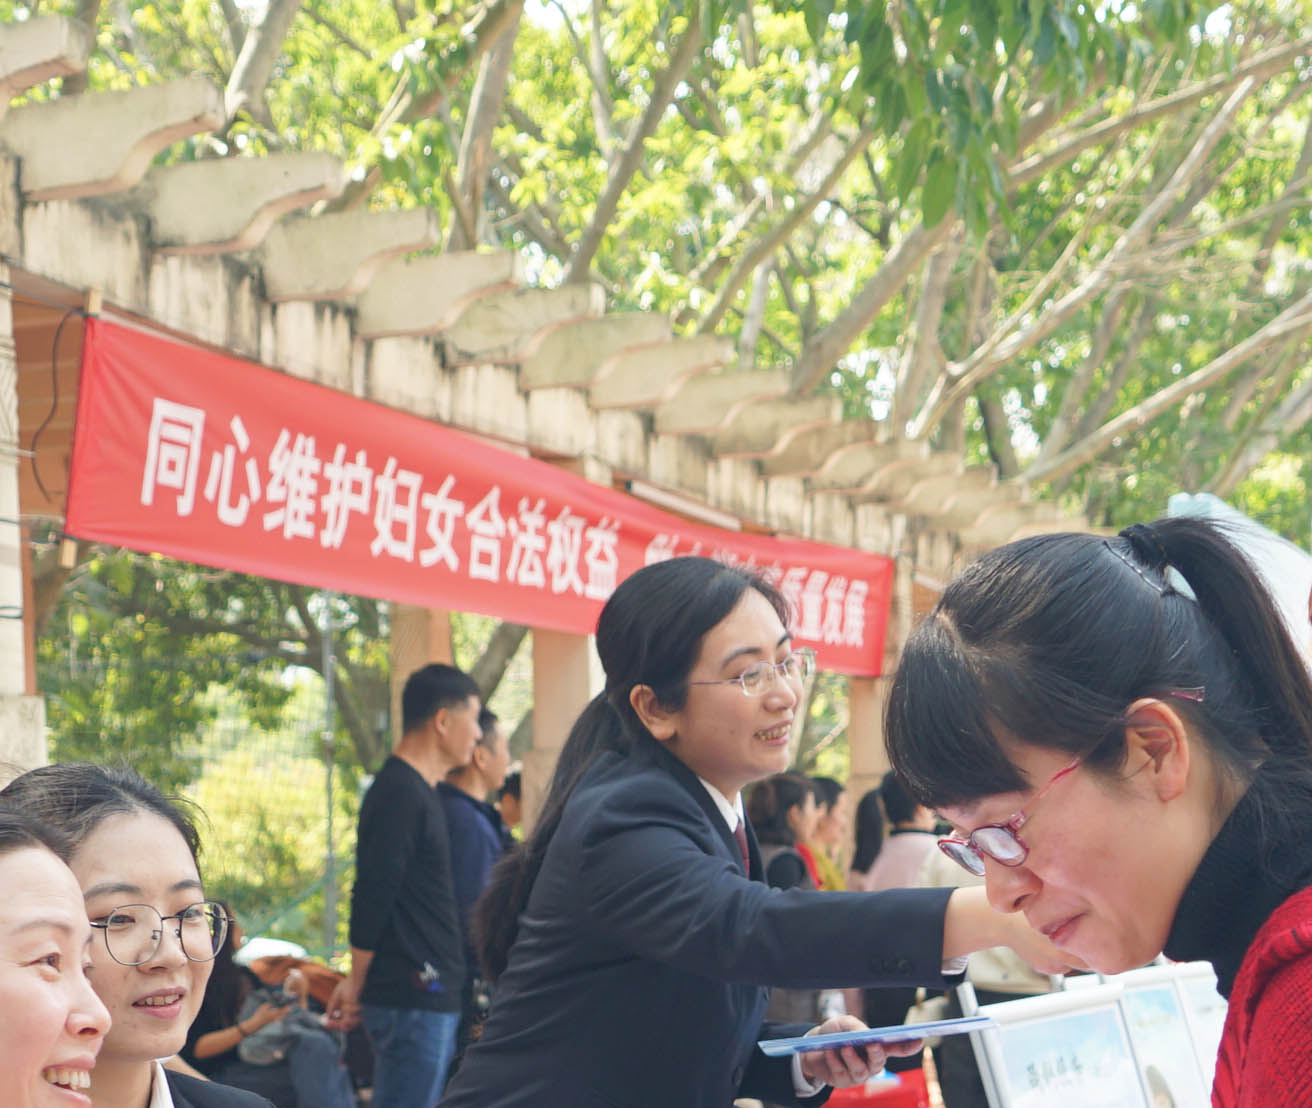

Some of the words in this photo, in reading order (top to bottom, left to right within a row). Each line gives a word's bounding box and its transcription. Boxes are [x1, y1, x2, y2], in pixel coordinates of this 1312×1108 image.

[140, 397, 621, 601] 同心维护妇女合法权益
